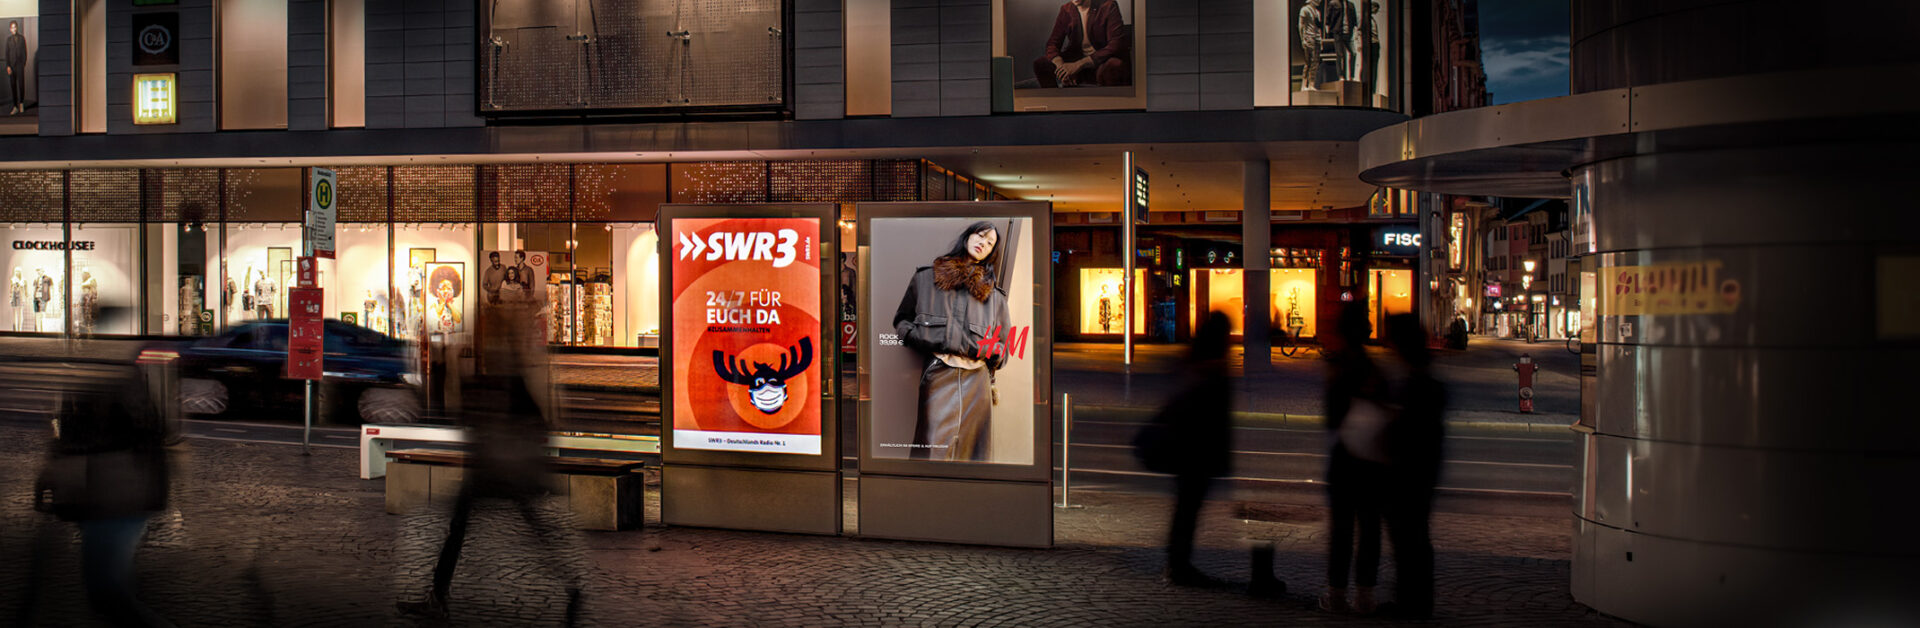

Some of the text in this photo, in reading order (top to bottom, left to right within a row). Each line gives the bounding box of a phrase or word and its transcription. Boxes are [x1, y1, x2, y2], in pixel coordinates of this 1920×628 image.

[320, 186, 328, 203] H
[706, 228, 799, 268] SWR3
[706, 288, 782, 308] 24/7 FÜR
[706, 308, 781, 325] EUCH DA
[976, 324, 1030, 361] H&M
